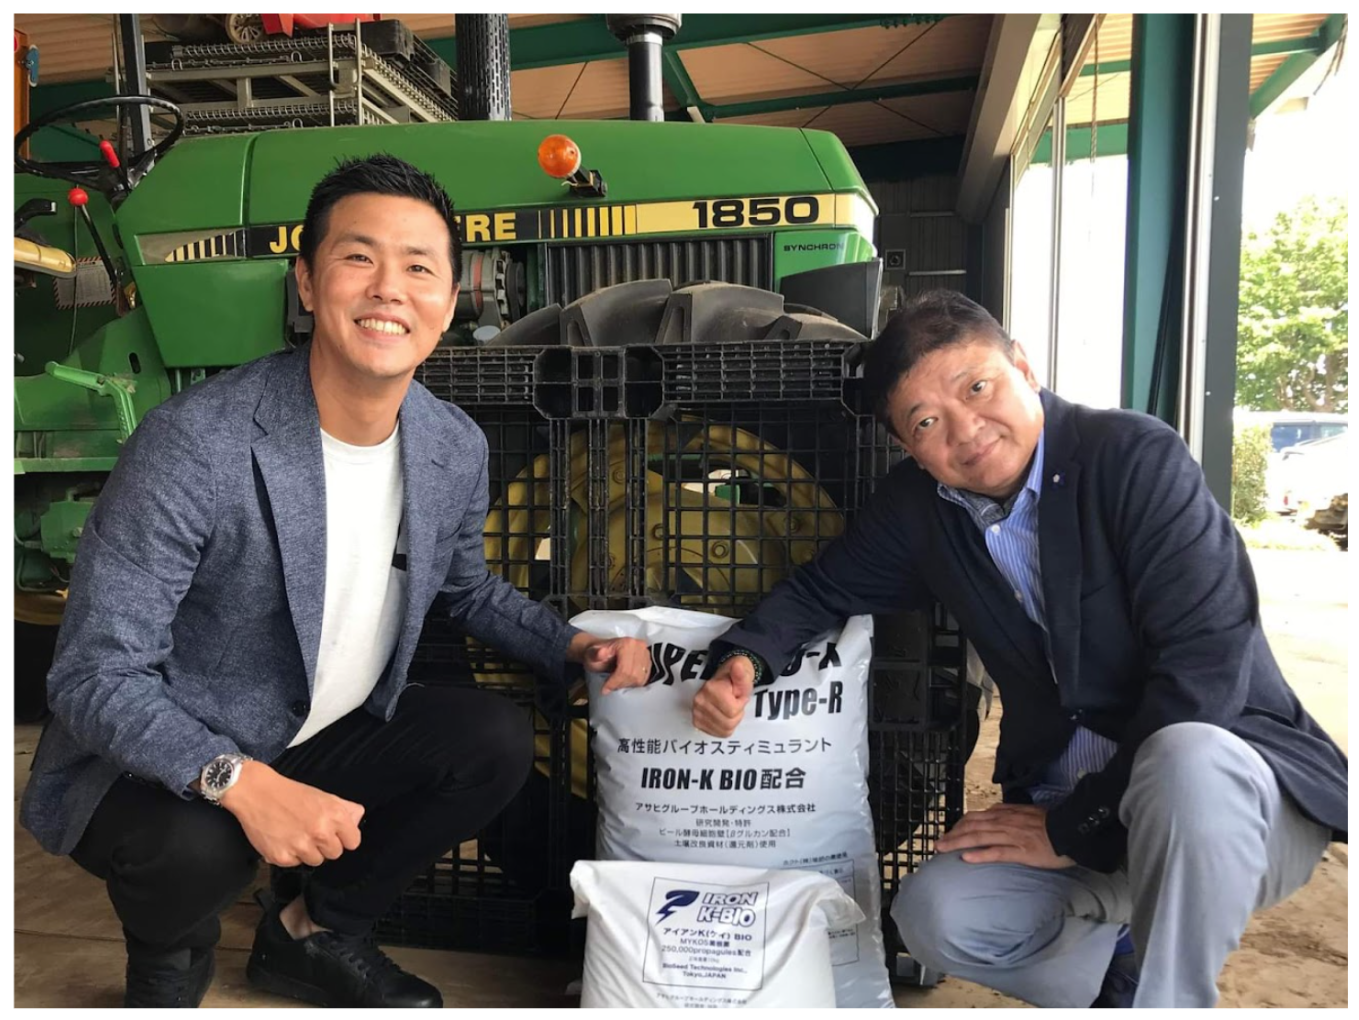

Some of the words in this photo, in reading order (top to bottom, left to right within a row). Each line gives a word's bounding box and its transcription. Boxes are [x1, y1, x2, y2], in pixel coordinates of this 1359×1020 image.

[693, 196, 820, 229] 1850
[754, 681, 844, 721] Type-R
[617, 737, 832, 755] 高性能バイオスティミュラント
[641, 767, 714, 790] IRON-K
[636, 802, 816, 813] アサヒグループホールディングス株式会社
[702, 891, 759, 906] IRON
[696, 906, 756, 928] K-BIO
